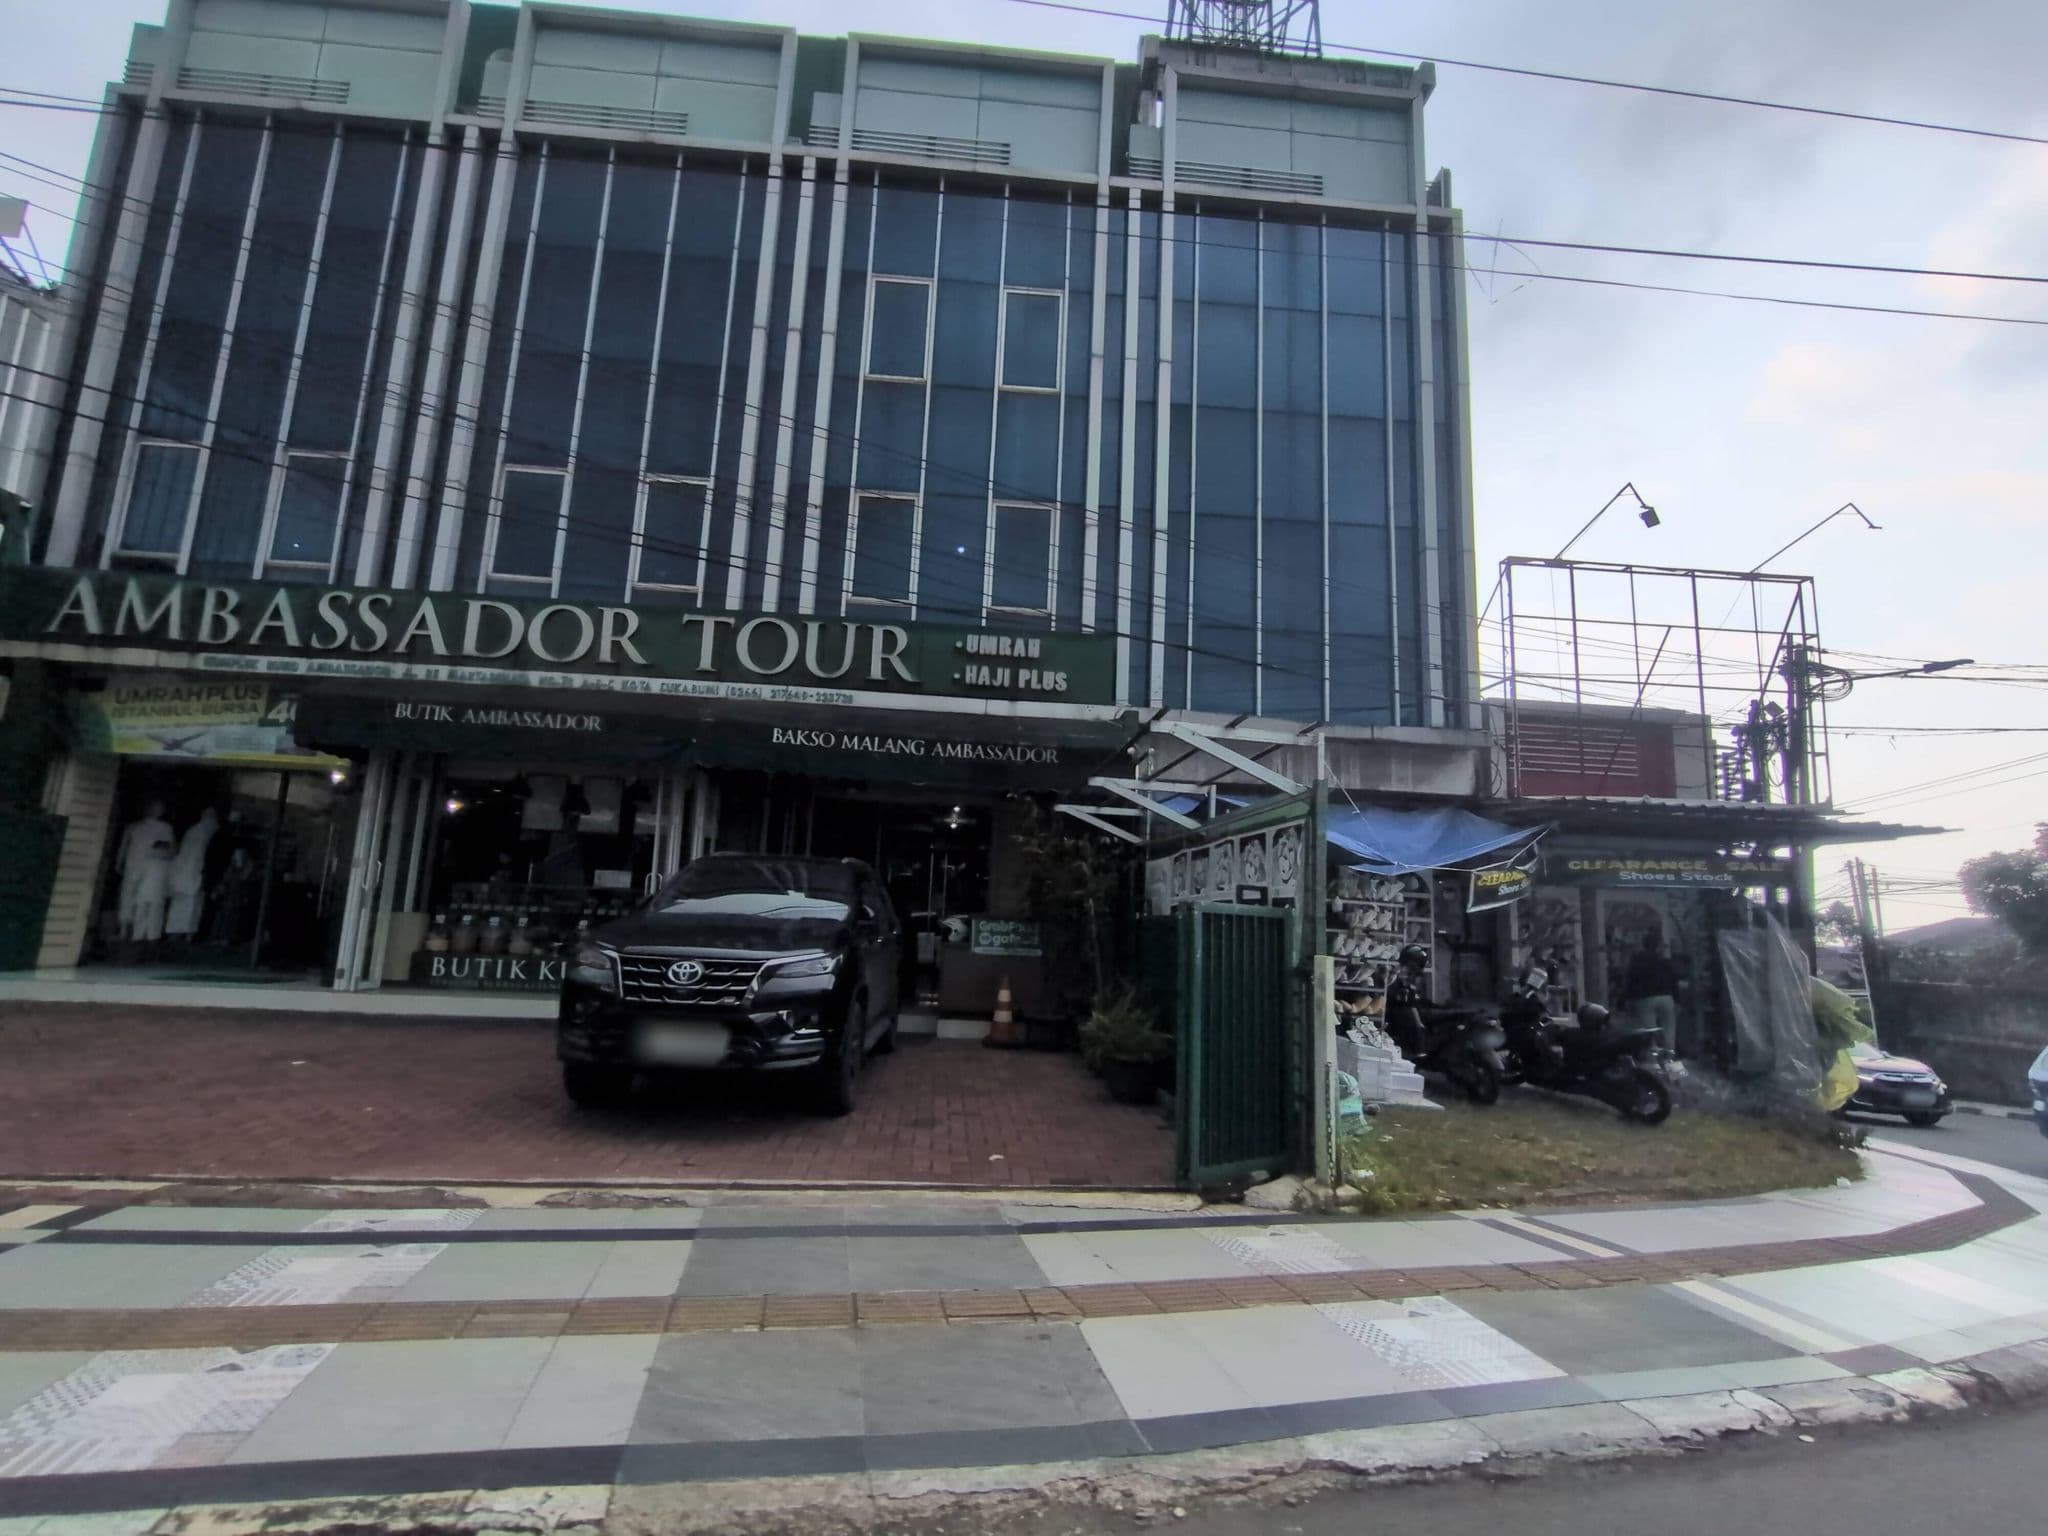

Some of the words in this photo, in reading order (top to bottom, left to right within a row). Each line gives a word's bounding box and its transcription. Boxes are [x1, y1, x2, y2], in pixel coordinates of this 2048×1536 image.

[47, 576, 650, 665] AMBASSADOR
[682, 613, 921, 684] TOUR
[966, 634, 1041, 659] UMRAH
[965, 664, 1010, 688] HAJI
[1018, 668, 1067, 692] PLUS
[394, 702, 456, 722] BUTIK
[461, 708, 602, 731] AMBASSADOR
[770, 727, 836, 749] BAKSO
[841, 734, 925, 756] MALANG
[932, 742, 1060, 765] AMBASSADOR
[1618, 870, 1675, 882] Shoes
[1681, 872, 1733, 883] Stock
[431, 956, 527, 980] BUTIK
